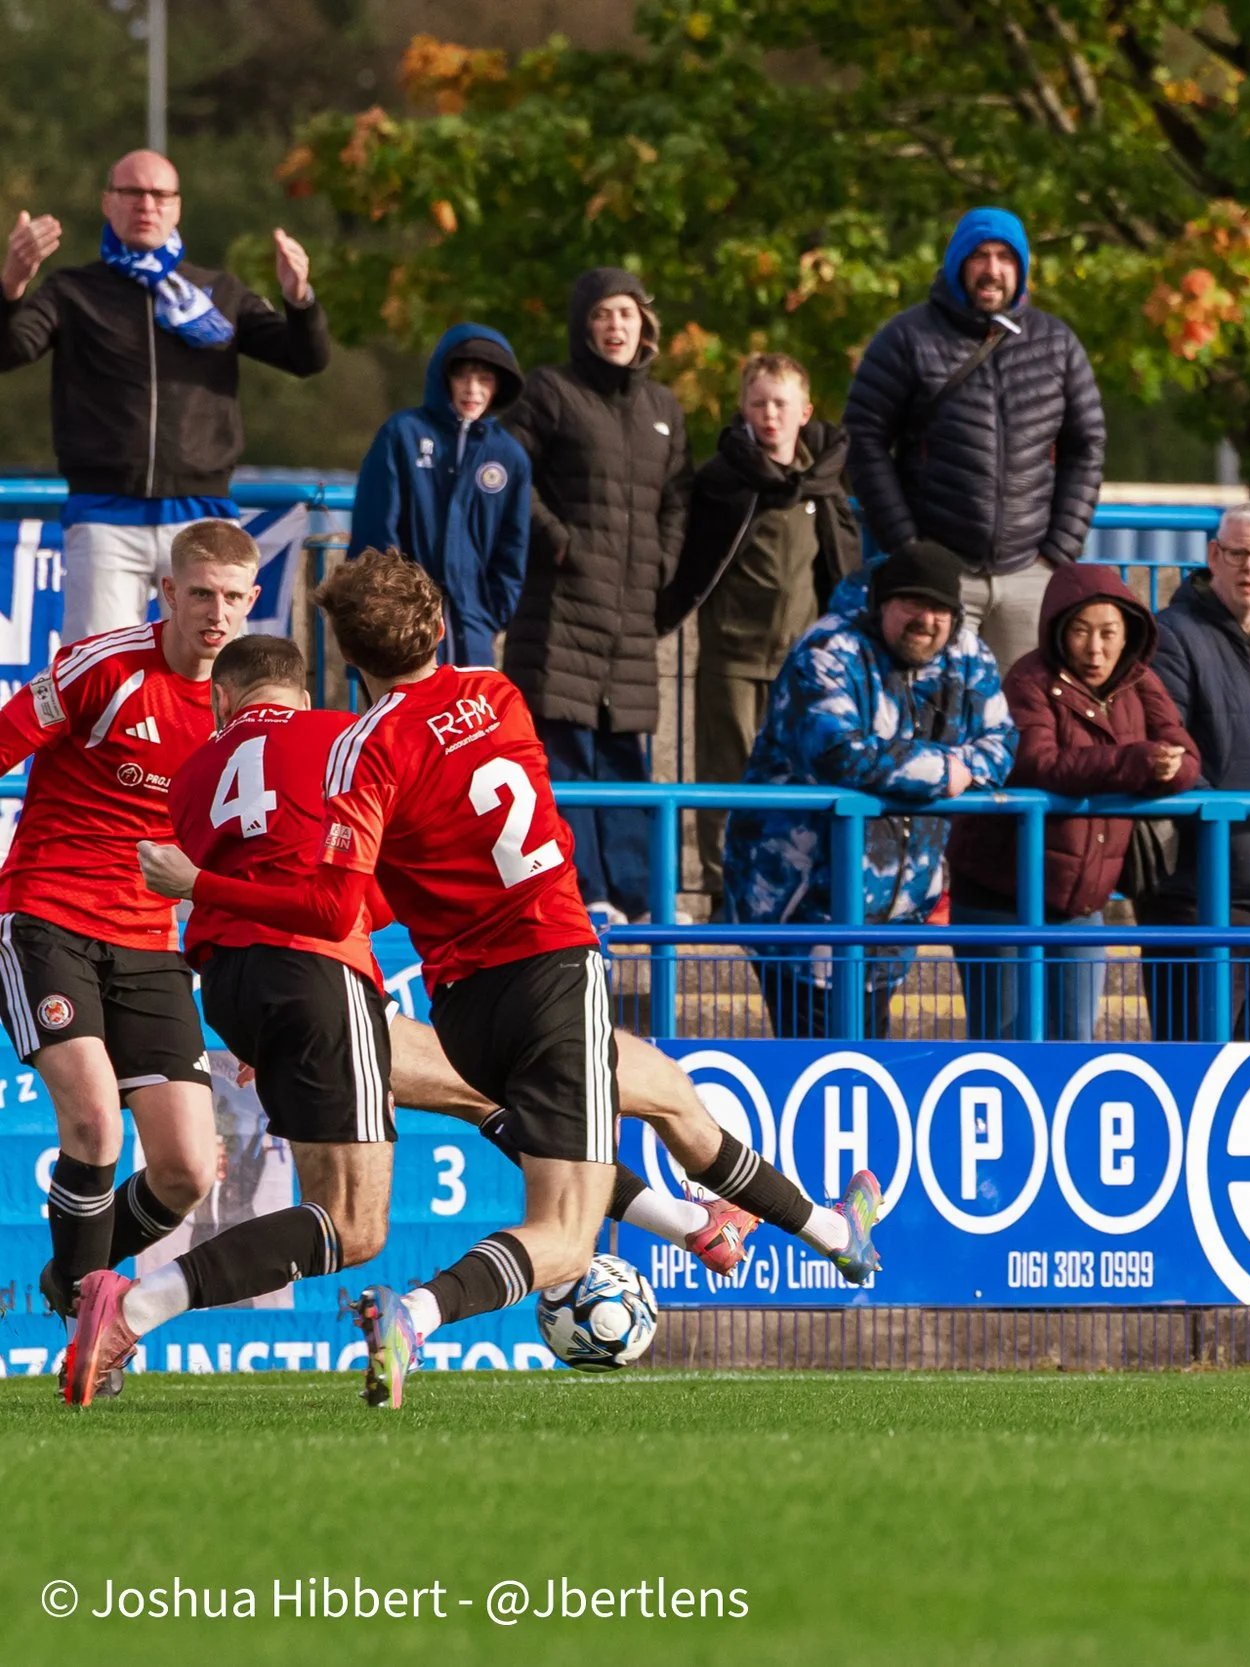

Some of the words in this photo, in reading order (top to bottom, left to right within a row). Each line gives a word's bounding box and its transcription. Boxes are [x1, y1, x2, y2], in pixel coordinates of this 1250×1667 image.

[209, 734, 278, 839] 4
[468, 756, 565, 890] 2
[430, 1145, 467, 1216] 3
[652, 1244, 699, 1289] HPE
[786, 1244, 875, 1289] Limi
[1008, 1251, 1048, 1288] 0161
[1054, 1251, 1095, 1288] 303
[1100, 1251, 1154, 1288] 0999
